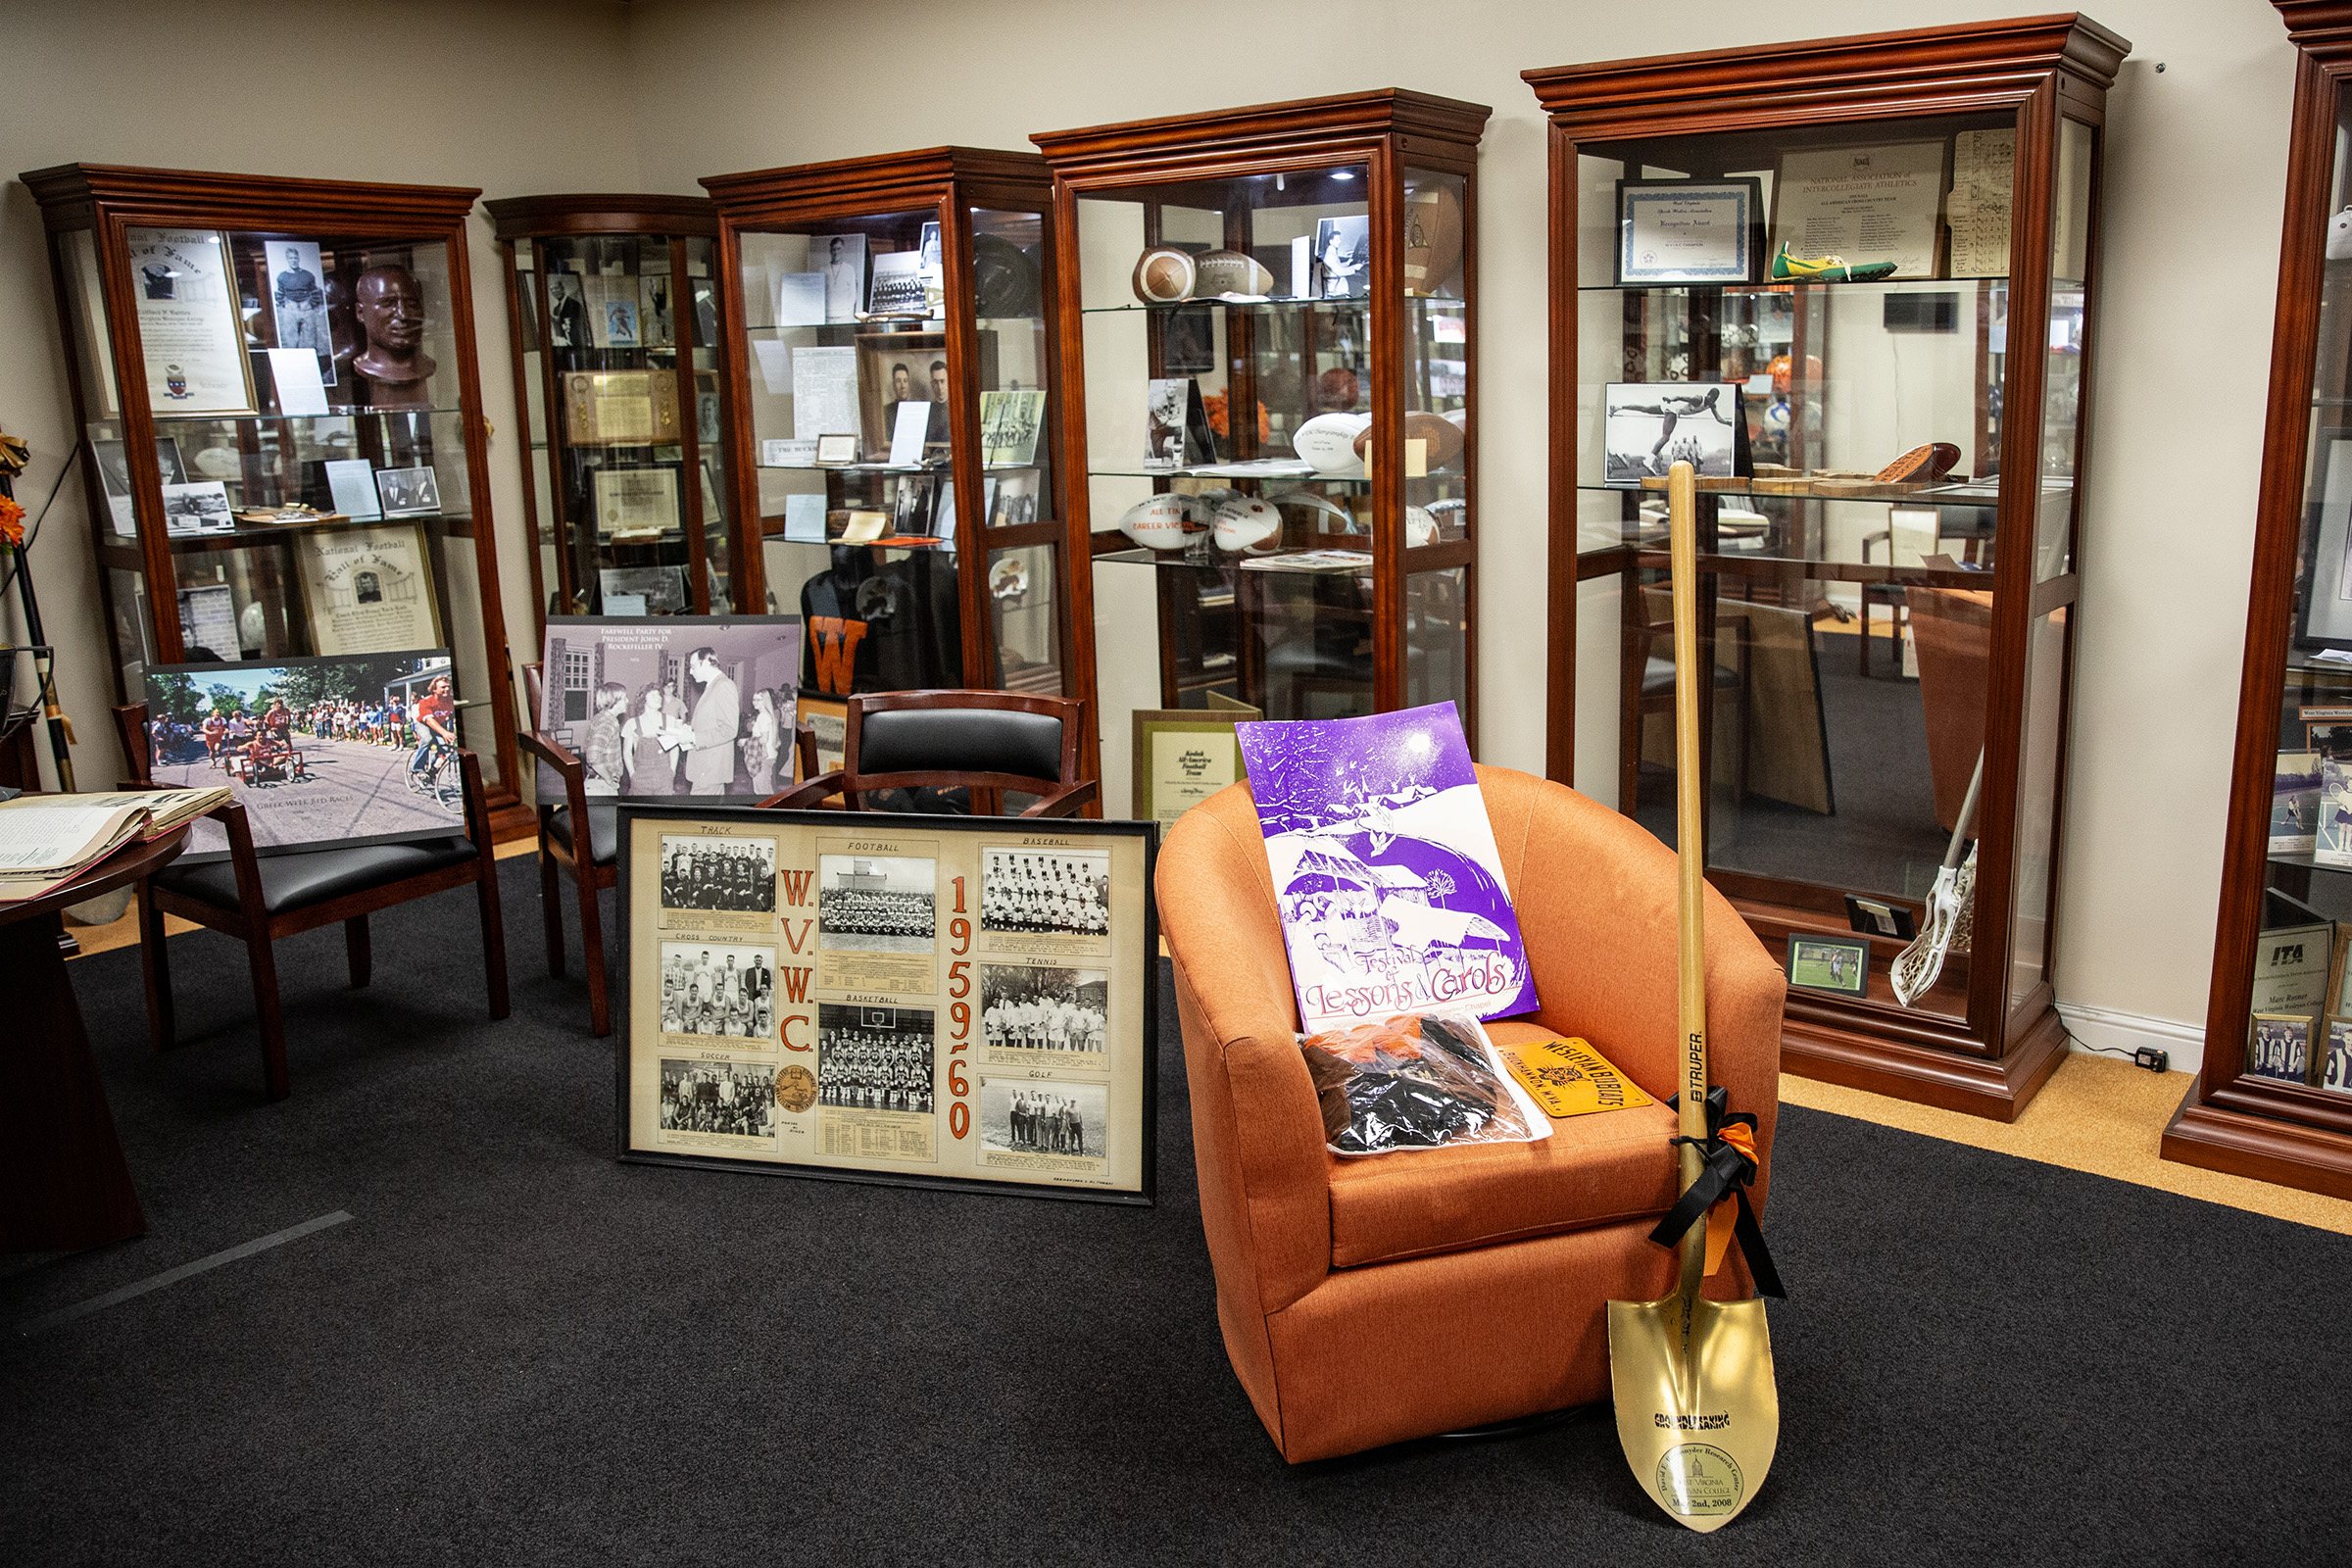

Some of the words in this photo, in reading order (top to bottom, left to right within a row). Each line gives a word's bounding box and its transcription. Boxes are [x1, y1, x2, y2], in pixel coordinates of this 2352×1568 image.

[1811, 175, 1849, 184] NATIONAL
[1851, 172, 1902, 181] ASSOCIATION
[1803, 183, 1873, 193] INTERCOLLEGIATE
[157, 232, 205, 244] Football
[164, 245, 202, 274] Fame
[1150, 508, 1162, 516] ALL
[1132, 522, 1162, 531] CAREER
[315, 546, 359, 557] National
[366, 540, 406, 552] Football
[324, 562, 350, 581] Hall
[354, 556, 365, 564] of
[371, 554, 403, 576] Fame
[809, 615, 868, 694] W
[701, 826, 731, 835] TRACK
[848, 842, 900, 852] FOOTBALL
[1354, 945, 1424, 976] Festival
[2271, 945, 2304, 966] ITA
[1386, 966, 1401, 981] of
[1306, 981, 1414, 1016] Lessons
[1431, 951, 1506, 1002] Carols
[846, 994, 899, 1004] BASKETBALL
[2269, 996, 2285, 1004] Marc
[2286, 993, 2307, 1003] Rosner
[1464, 1000, 1492, 1010] Chapel
[701, 1052, 731, 1060] SOCCER
[1690, 1032, 1703, 1089] TRUPER
[1543, 1041, 1603, 1072] WESLEYAN
[1589, 1071, 1624, 1106] BOBCATS
[1704, 1447, 1733, 1469] Research
[1731, 1468, 1740, 1492] Center
[1691, 1499, 1710, 1508] 2nd,
[1712, 1498, 1732, 1507] 2008
